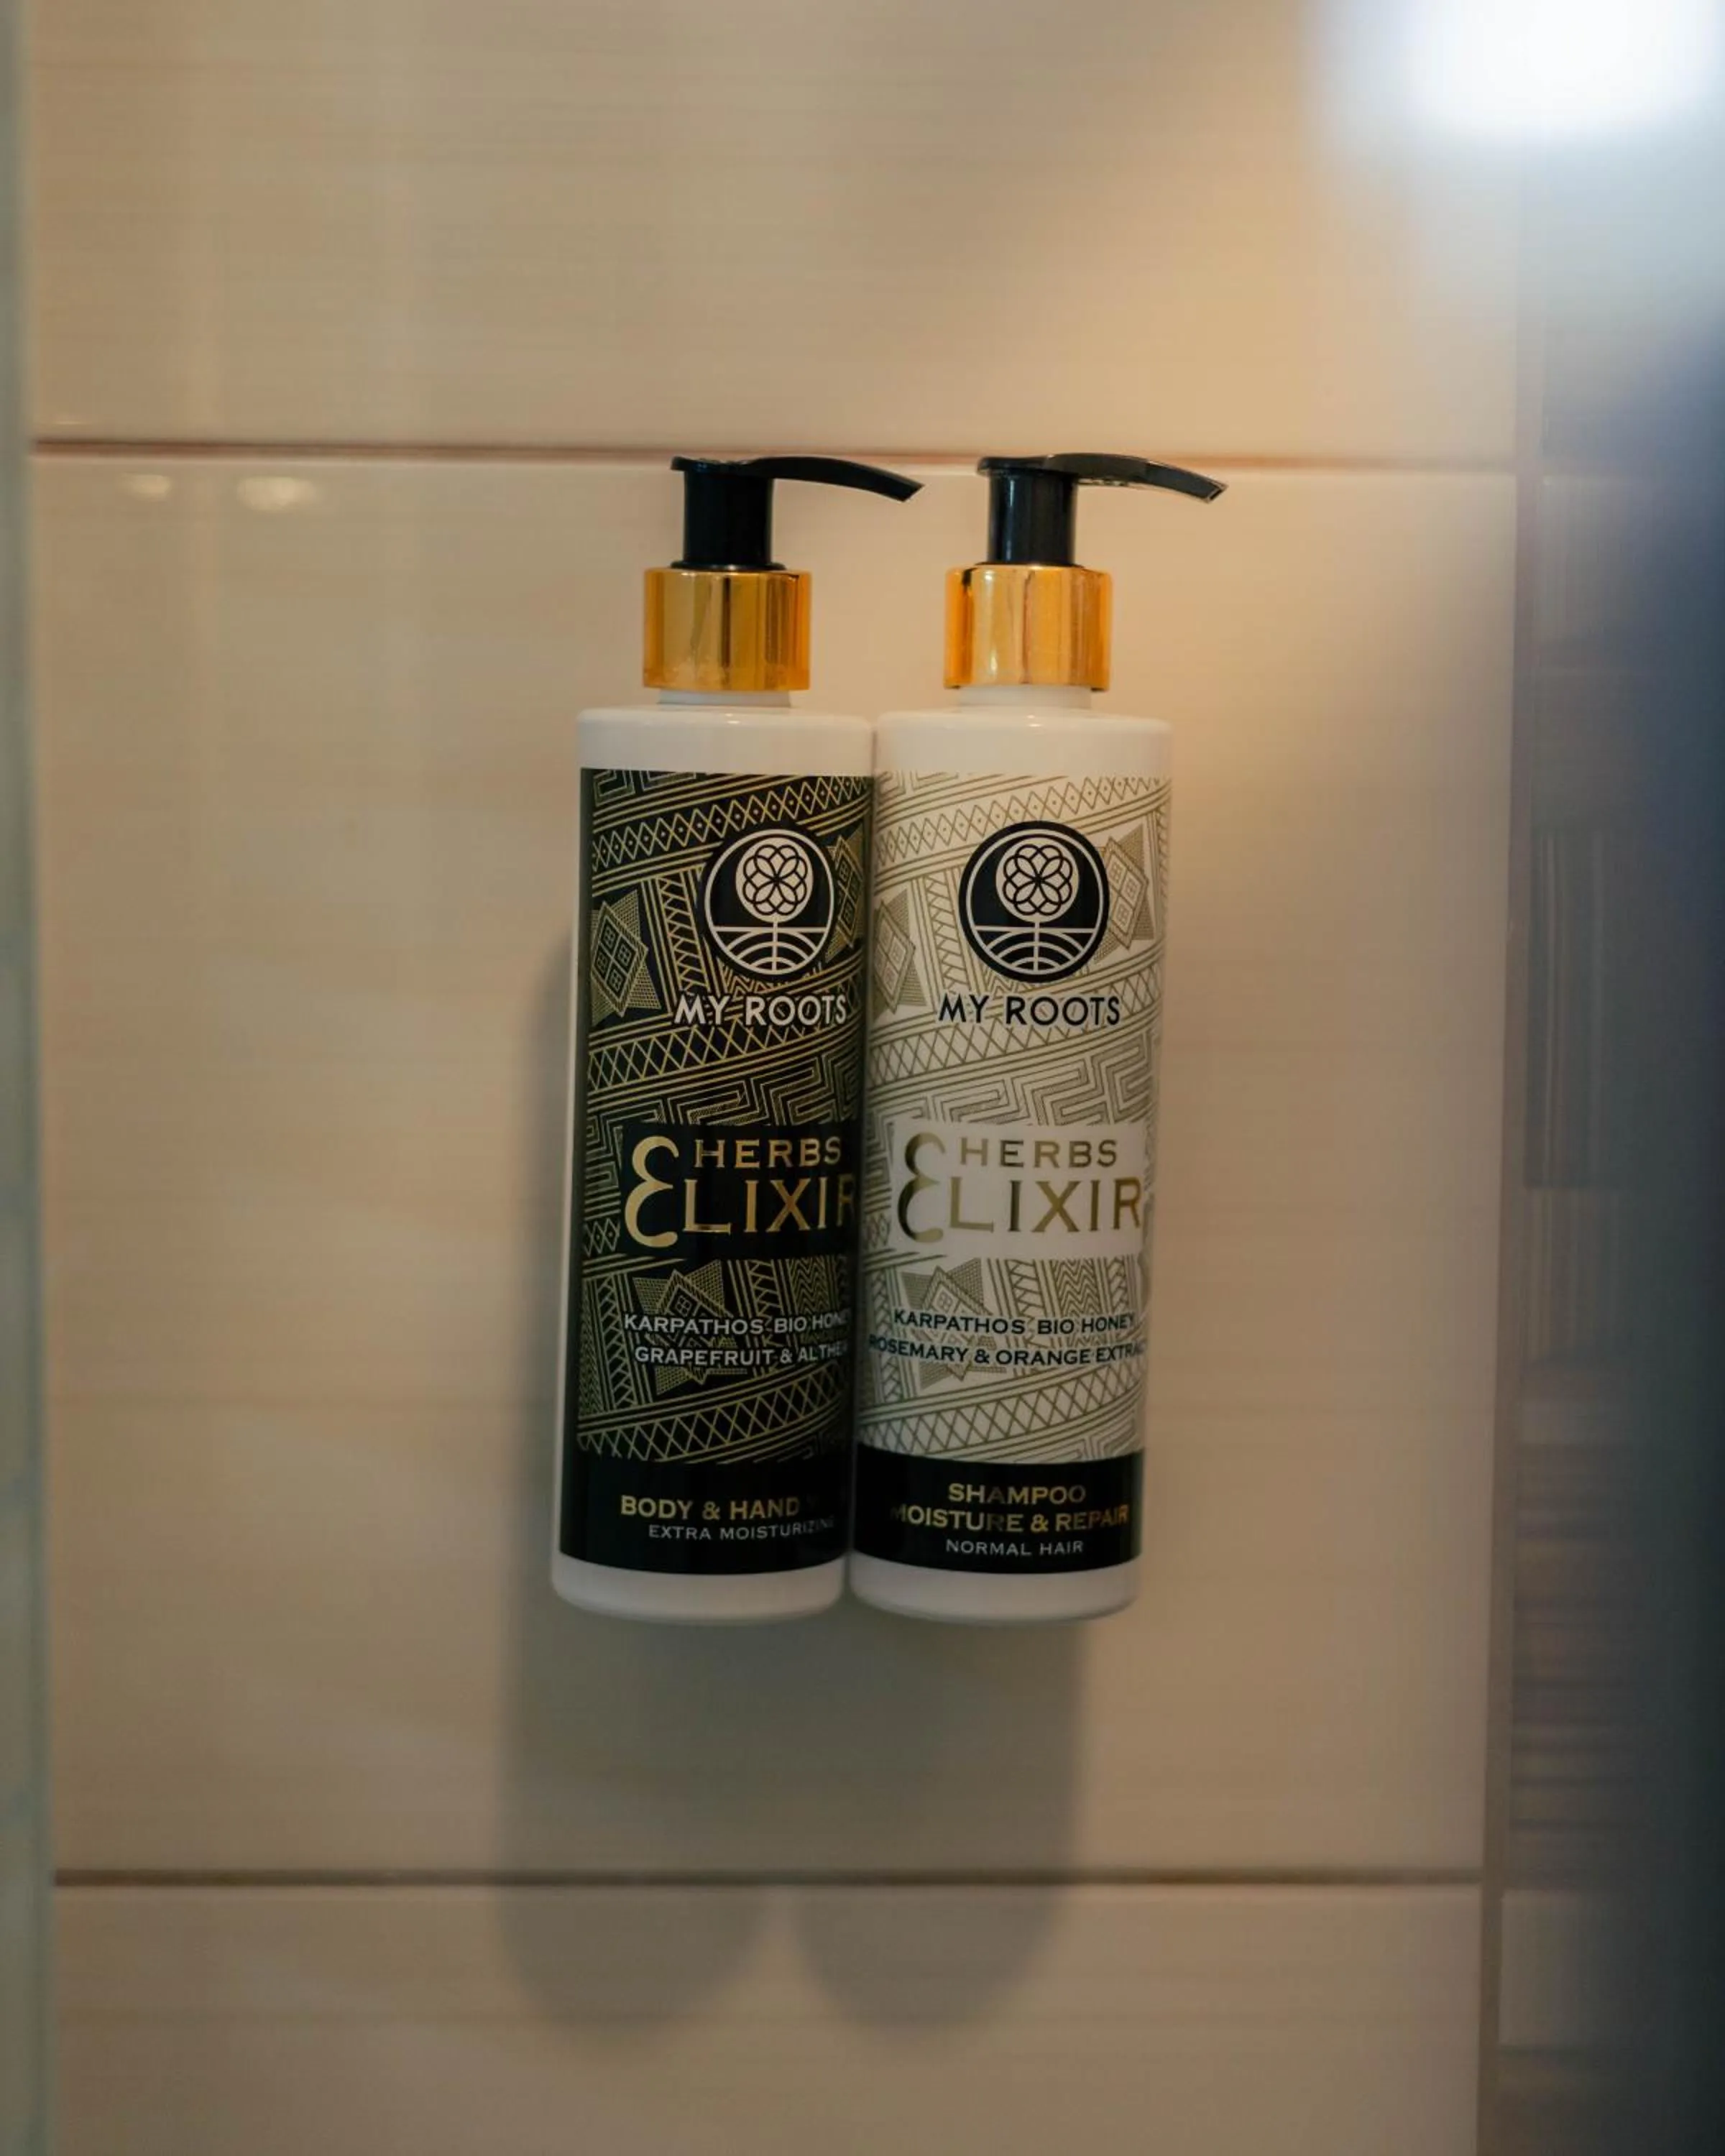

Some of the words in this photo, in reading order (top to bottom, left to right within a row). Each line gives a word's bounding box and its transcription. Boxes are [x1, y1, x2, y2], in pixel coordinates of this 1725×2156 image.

[674, 994, 731, 1025] MY
[745, 994, 847, 1026] ROOTS
[939, 992, 990, 1024] MY
[1006, 995, 1121, 1026] ROOTS
[693, 1136, 842, 1169] HERBS
[960, 1137, 1118, 1169] HERBS
[897, 1132, 1142, 1243] ELIXIR
[624, 1313, 765, 1335] KARPATHOS
[774, 1316, 808, 1335] BIO
[894, 1309, 1026, 1335] KARPATHOS
[1038, 1319, 1075, 1335] BIO
[634, 1346, 775, 1365] GRAPEFRUIT
[780, 1348, 794, 1365] &
[975, 1348, 990, 1364] &
[995, 1349, 1091, 1365] ORANGE
[620, 1494, 694, 1520] BODY
[702, 1500, 721, 1521] &
[730, 1496, 801, 1521] HAND
[948, 1483, 1086, 1506] SHAMPOO
[1030, 1514, 1049, 1533] &
[1055, 1504, 1130, 1532] REPAIR
[648, 1524, 712, 1540] EXTRA
[946, 1539, 1032, 1557] NORMAL
[1039, 1540, 1085, 1557] HAIR
